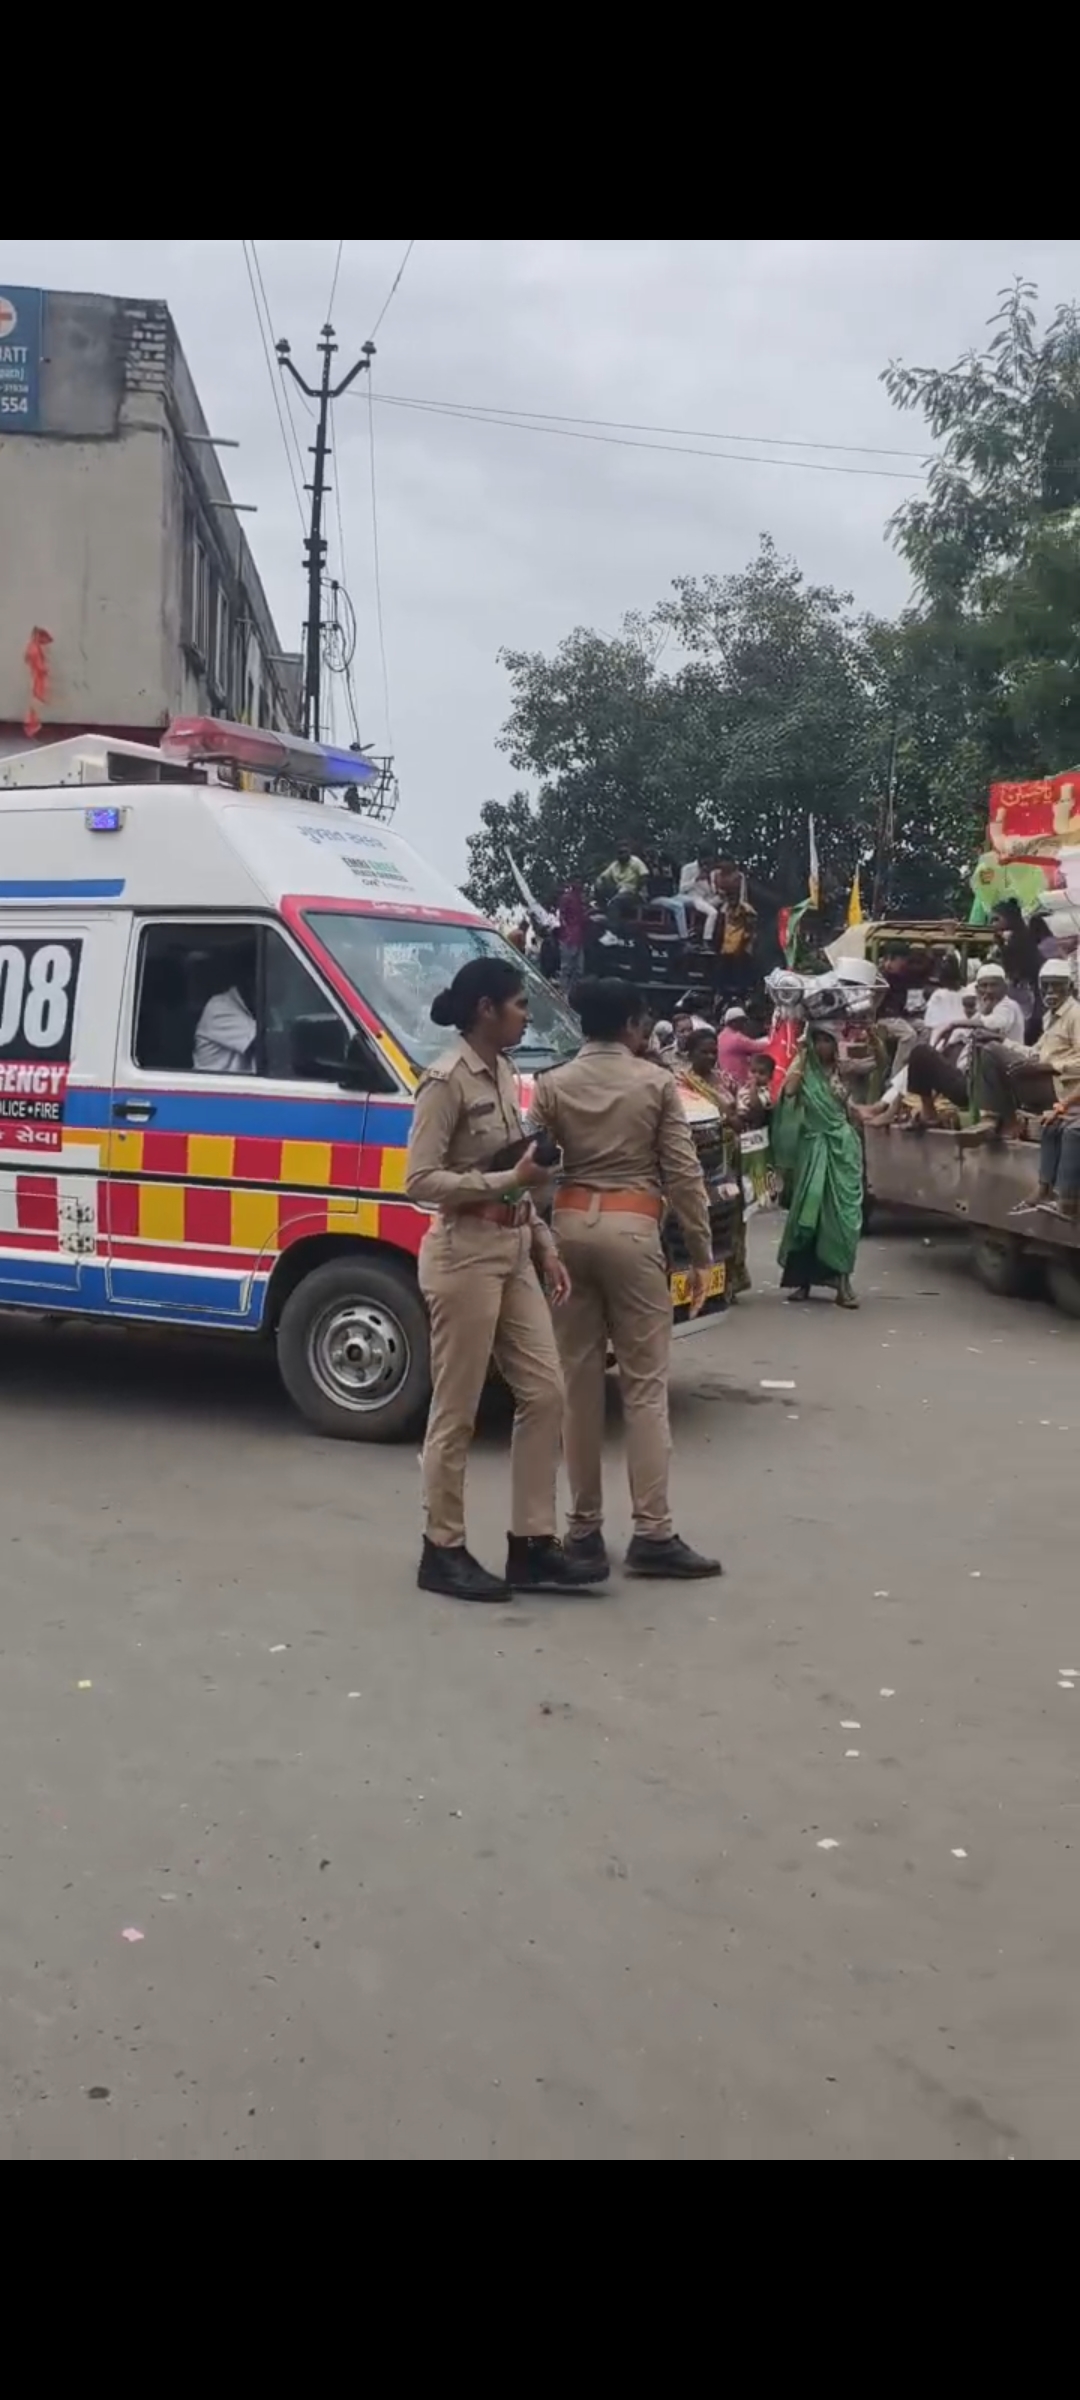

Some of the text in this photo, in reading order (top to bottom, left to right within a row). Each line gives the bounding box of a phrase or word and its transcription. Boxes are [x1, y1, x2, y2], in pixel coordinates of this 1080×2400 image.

[1, 396, 28, 413] 554
[0, 1099, 27, 1118] LICE
[15, 1124, 58, 1145] સેવા
